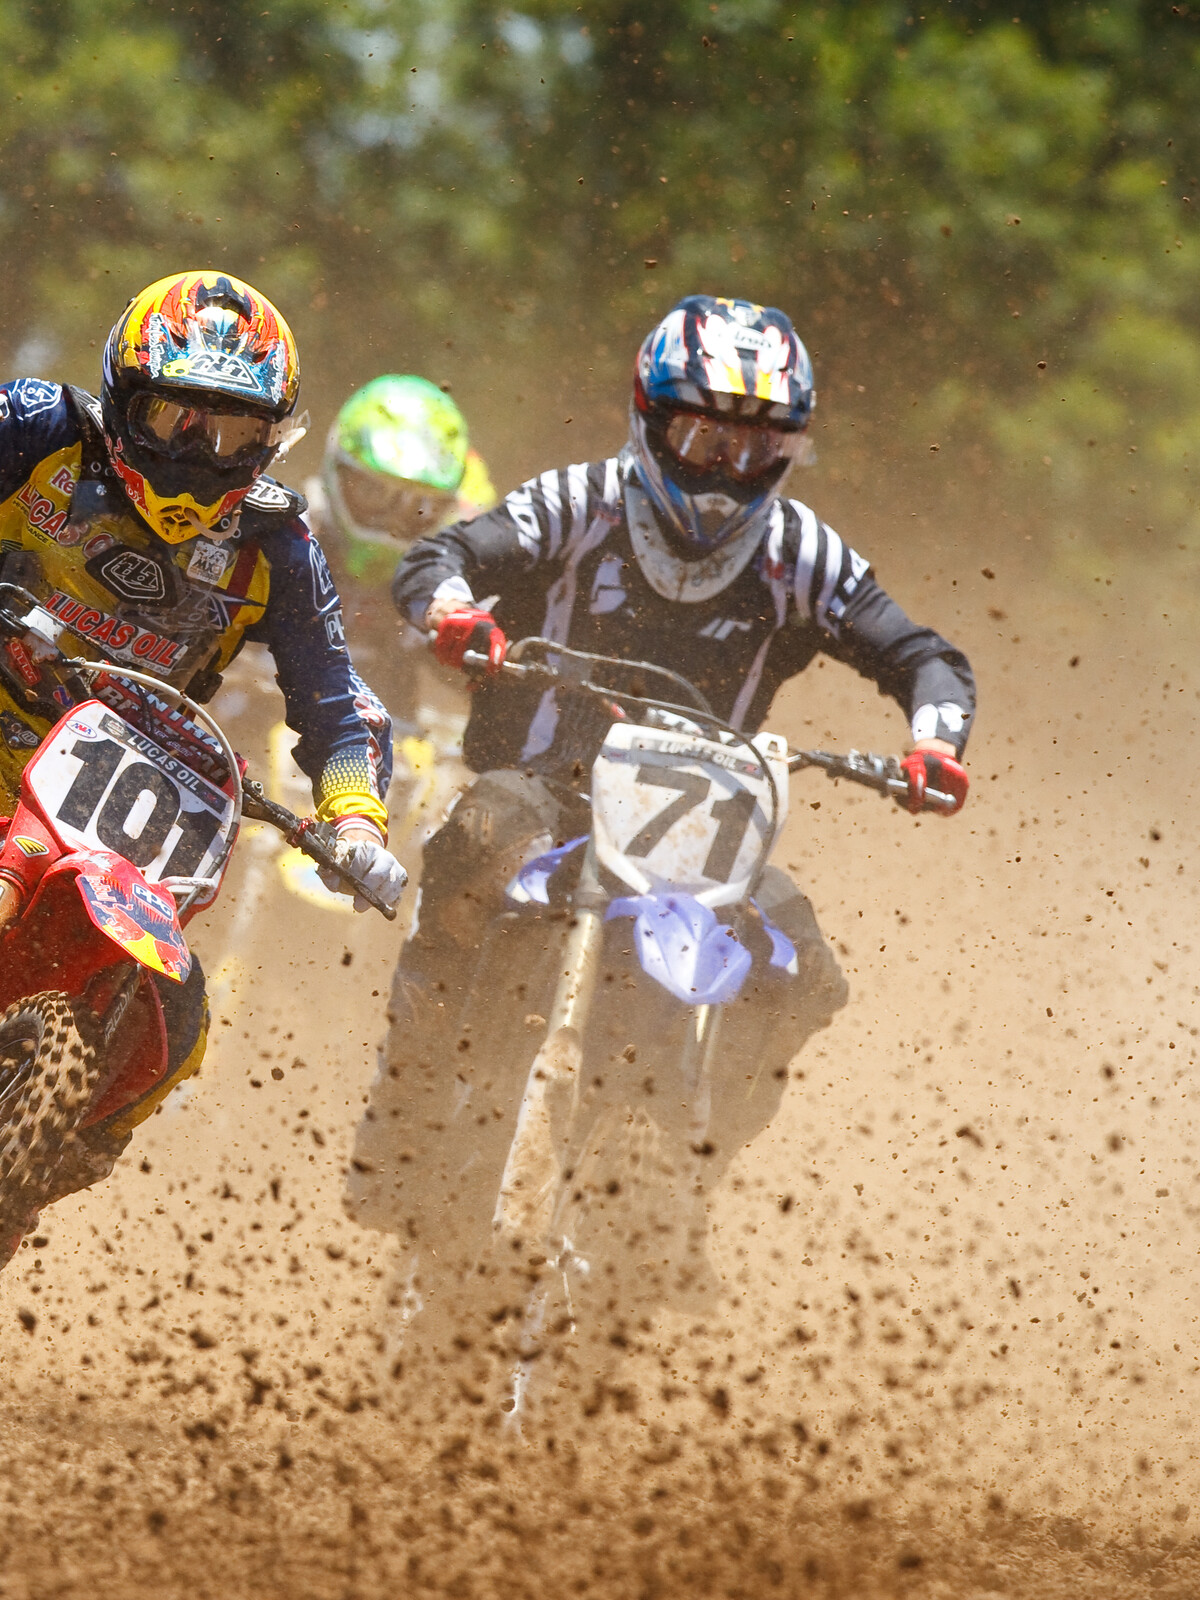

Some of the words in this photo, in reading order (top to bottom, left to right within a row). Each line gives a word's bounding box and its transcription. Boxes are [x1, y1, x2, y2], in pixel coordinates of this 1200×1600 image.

[51, 466, 75, 495] Re
[17, 484, 88, 546] LCAS
[44, 593, 135, 649] LUCAS
[131, 633, 180, 668] OIL
[109, 674, 224, 756] RENTHA
[126, 734, 178, 771] LUCAS
[176, 769, 199, 791] OIL
[56, 738, 224, 881] 101
[624, 765, 757, 884] 71
[135, 884, 172, 917] PPG
